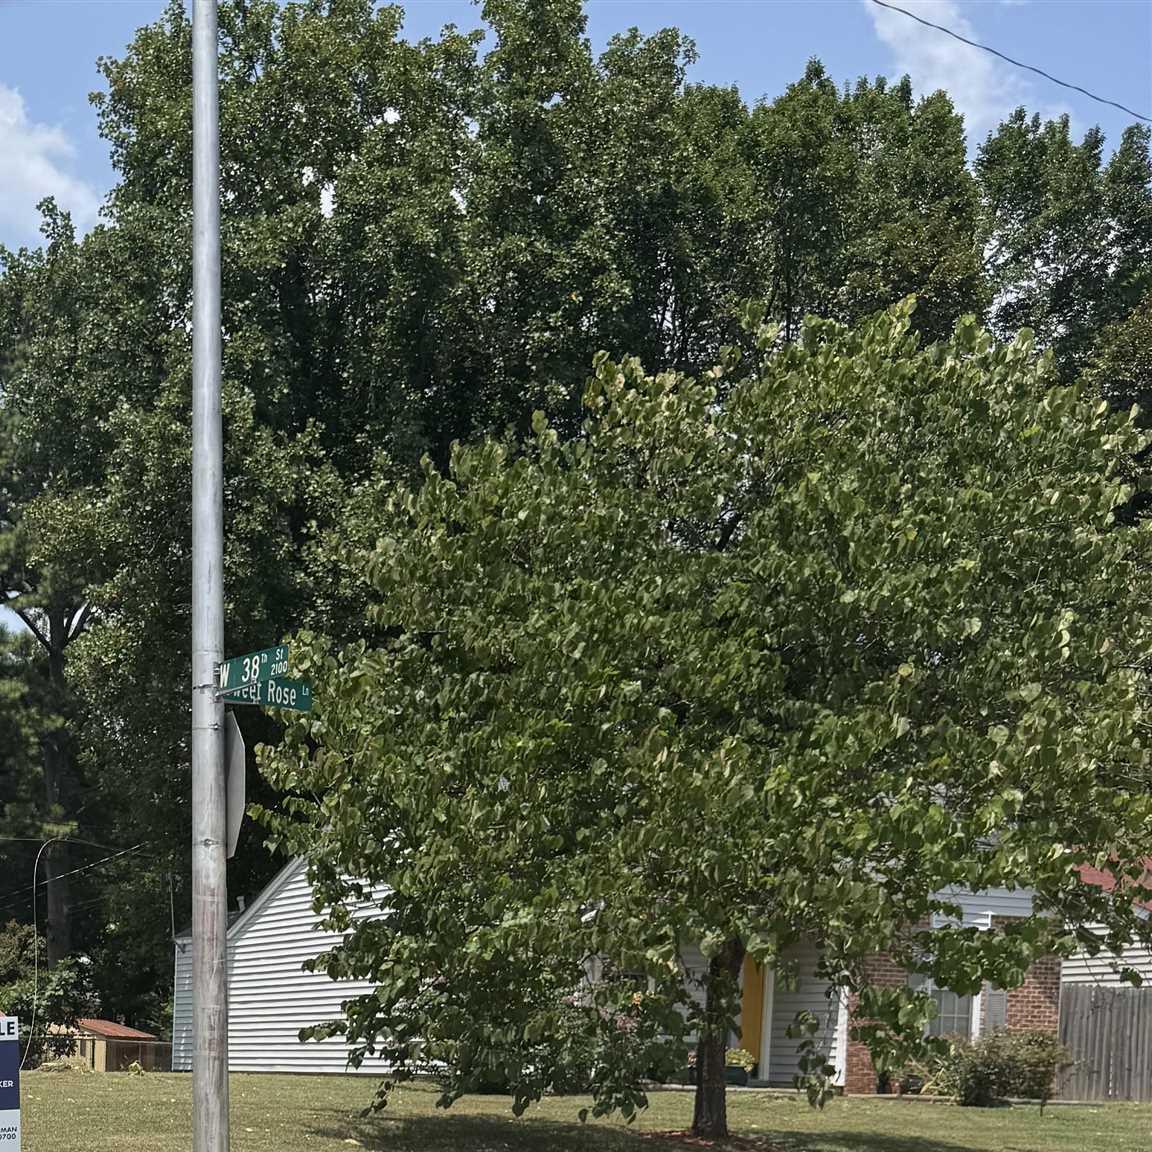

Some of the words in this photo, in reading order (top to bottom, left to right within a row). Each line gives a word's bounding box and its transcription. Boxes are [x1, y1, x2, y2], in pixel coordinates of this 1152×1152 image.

[220, 663, 230, 688] W
[275, 648, 284, 660] St
[270, 661, 288, 676] 2100
[268, 680, 296, 705] Rose
[302, 685, 309, 696] Ln
